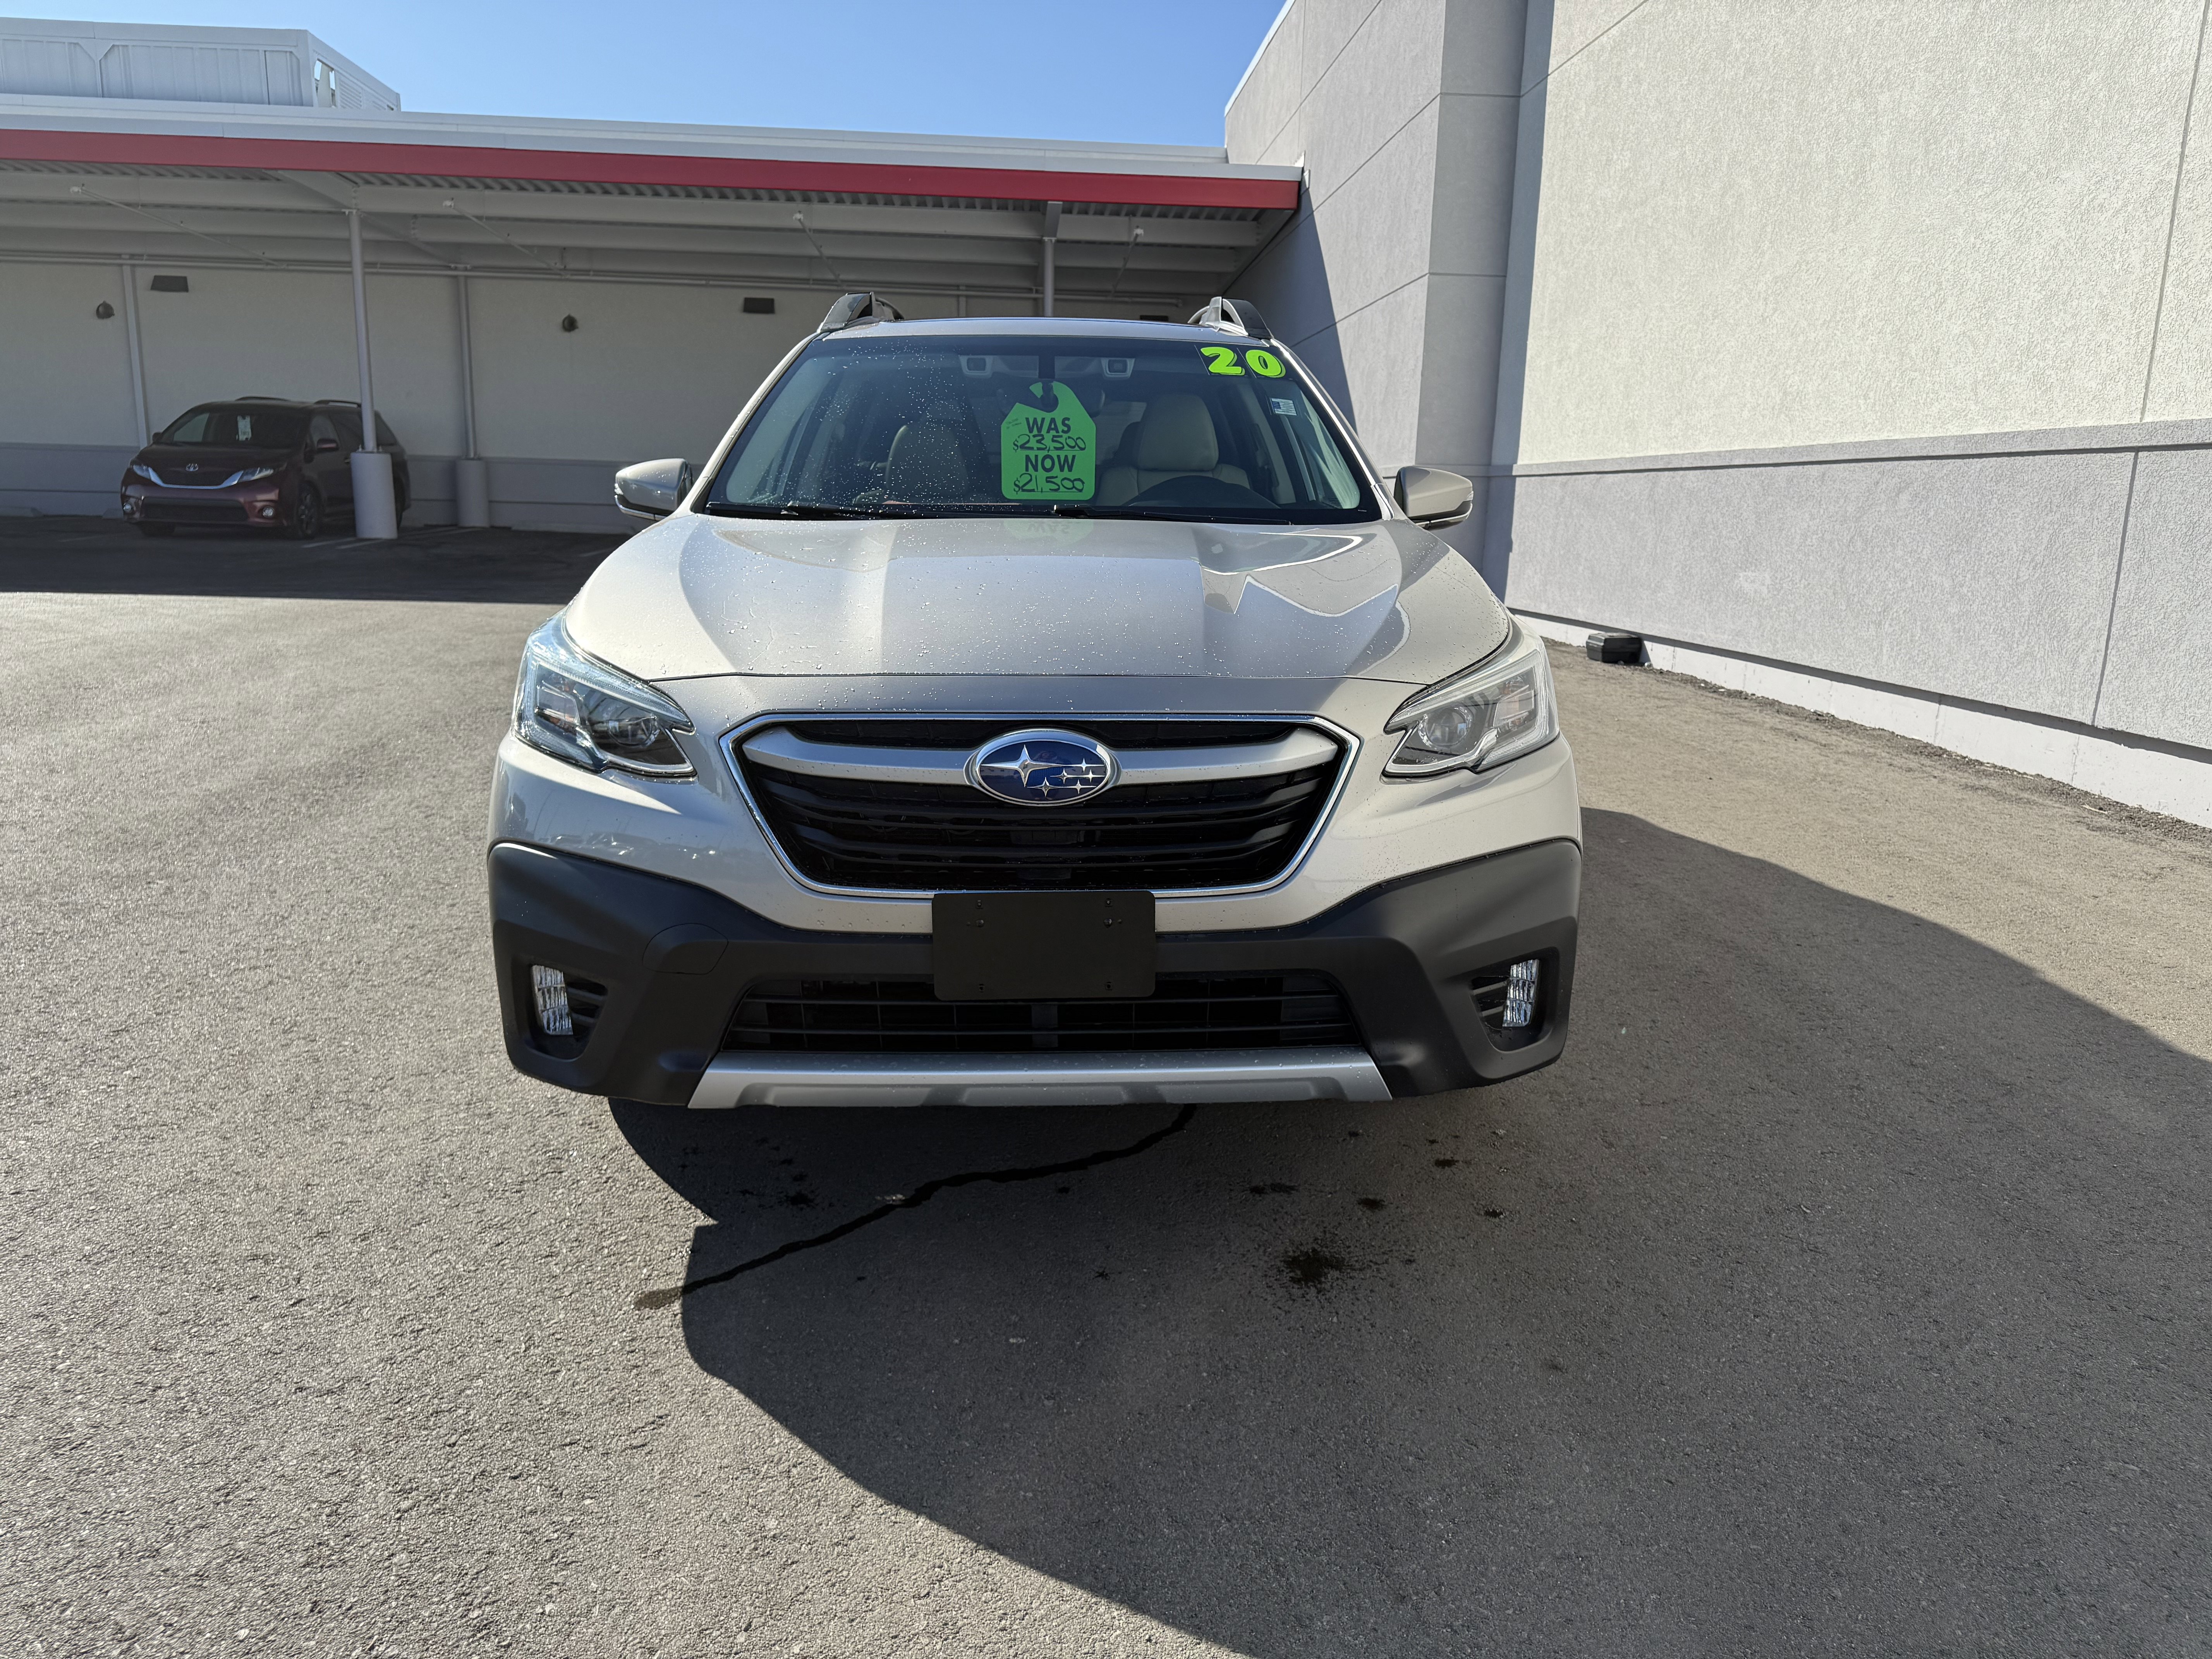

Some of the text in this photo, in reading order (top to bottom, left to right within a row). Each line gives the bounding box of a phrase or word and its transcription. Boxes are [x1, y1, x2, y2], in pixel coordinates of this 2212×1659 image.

[1200, 347, 1286, 378] 20
[1025, 417, 1071, 434] WAS
[1013, 434, 1086, 453] $23,500
[1025, 454, 1076, 472] NOW
[1013, 472, 1085, 495] $21,500
